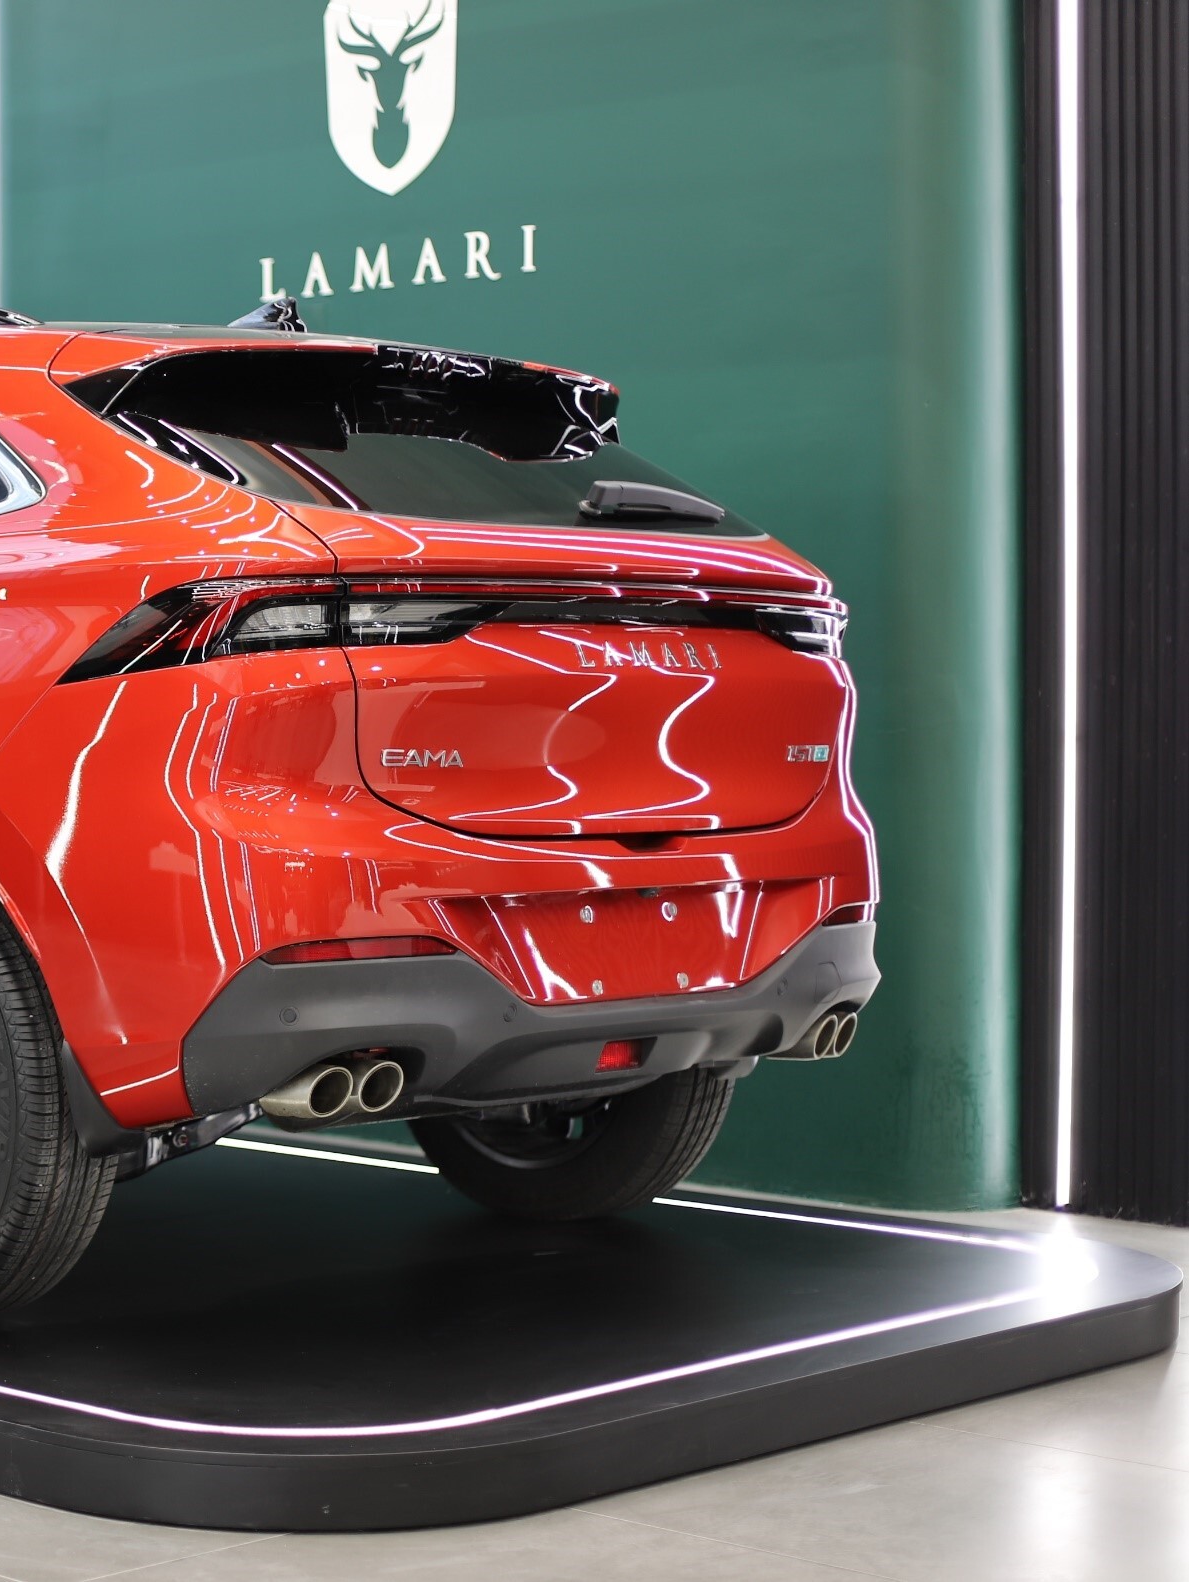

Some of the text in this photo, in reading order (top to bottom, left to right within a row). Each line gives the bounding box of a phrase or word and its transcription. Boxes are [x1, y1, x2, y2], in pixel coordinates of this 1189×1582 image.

[259, 224, 537, 302] LAMARI
[574, 640, 723, 671] LAMARI
[381, 748, 464, 768] EAMA
